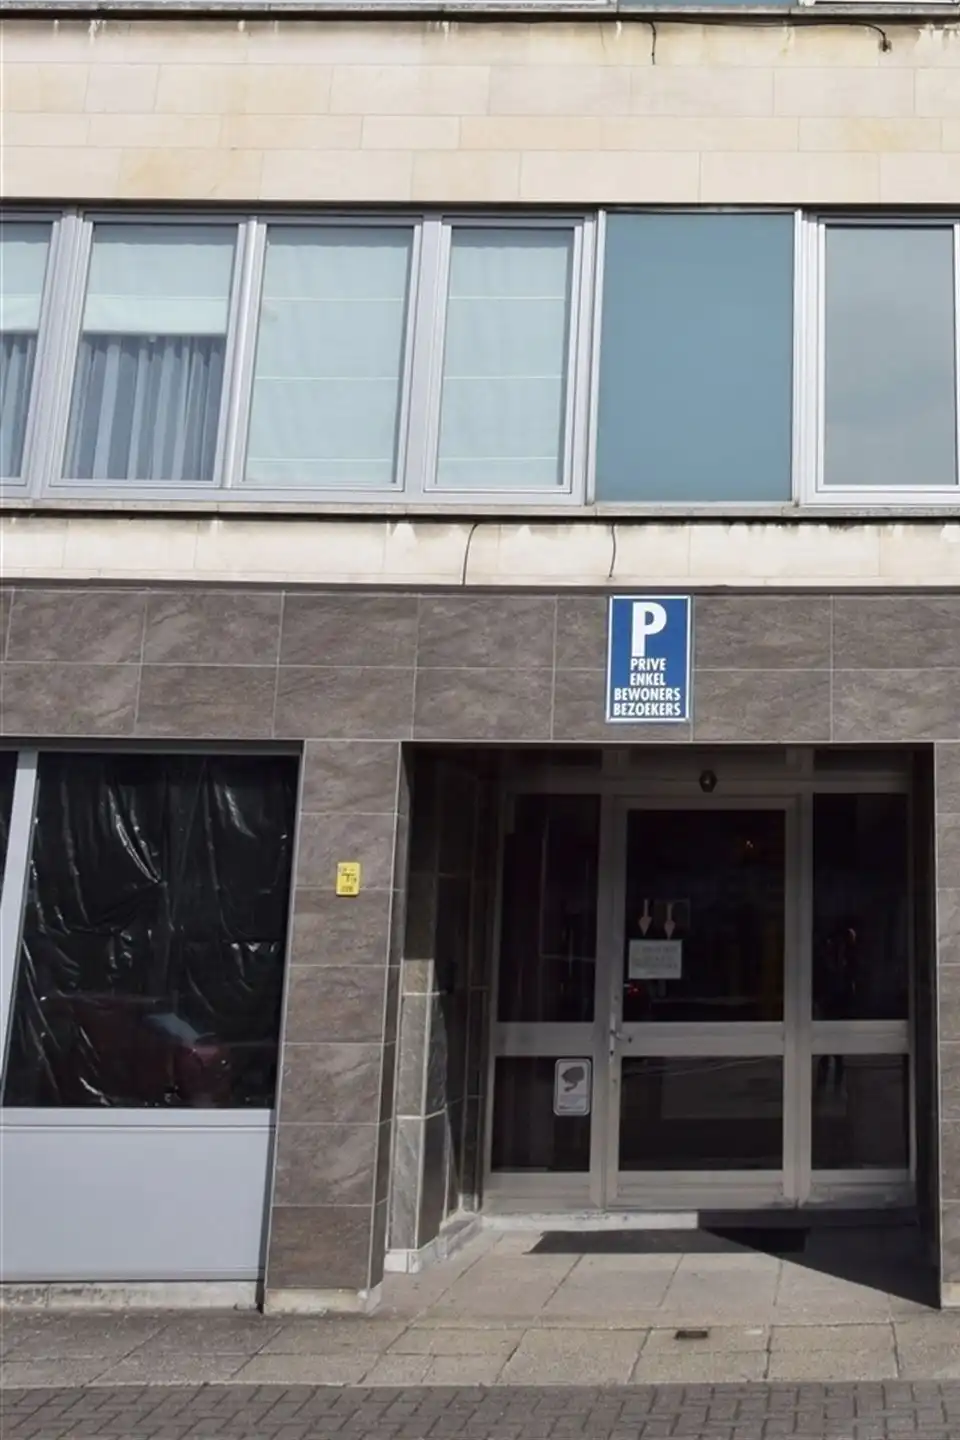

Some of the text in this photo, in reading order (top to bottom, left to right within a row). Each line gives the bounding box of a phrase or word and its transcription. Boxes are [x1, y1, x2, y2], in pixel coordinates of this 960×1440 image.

[631, 601, 667, 657] P
[630, 658, 667, 671] PRIVE
[629, 673, 666, 686] ENKEL
[613, 688, 681, 701] BEWONERS
[612, 703, 681, 716] BEZOEKERS
